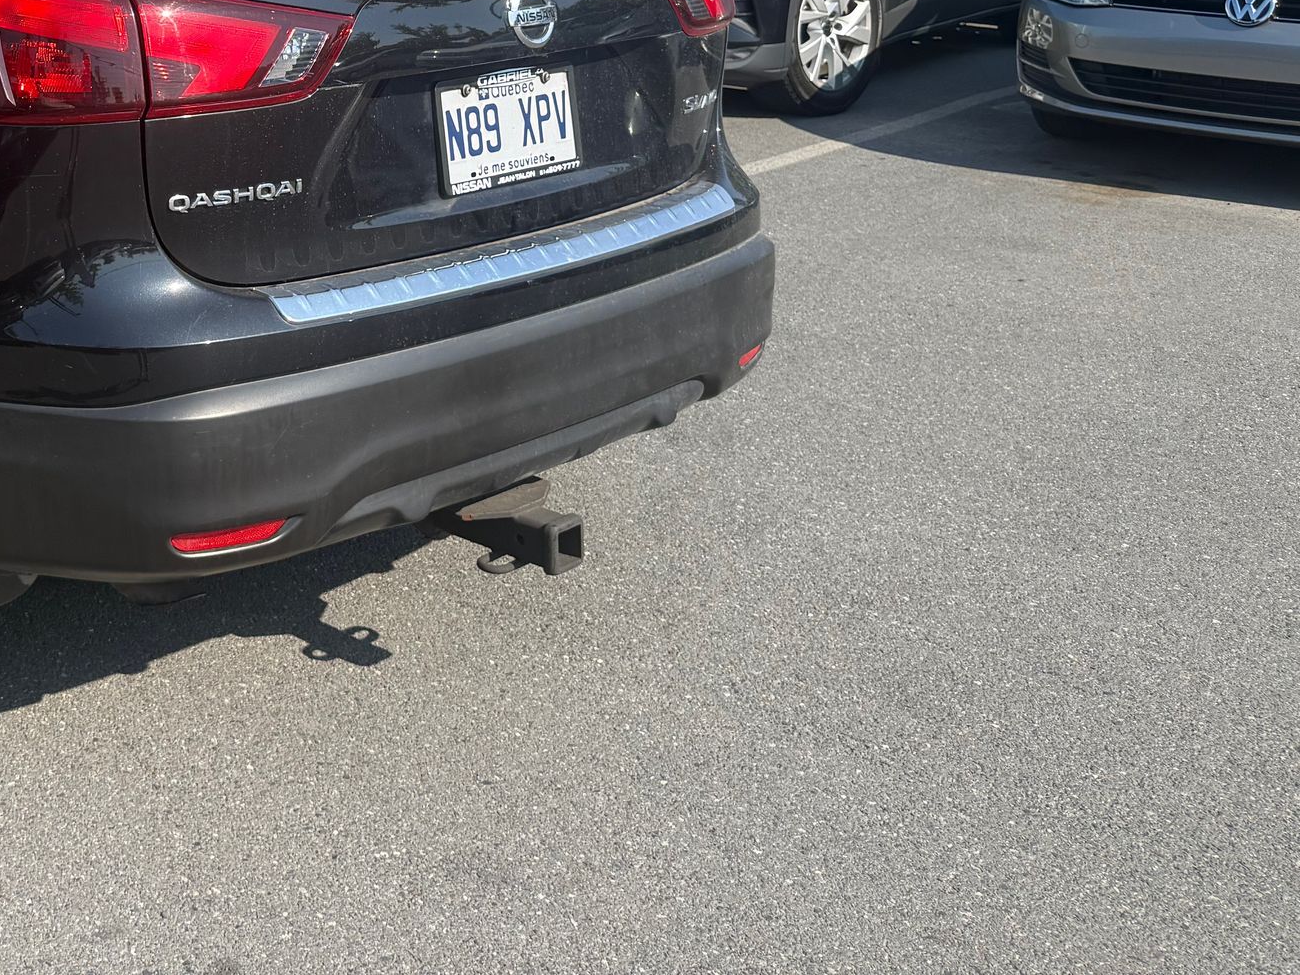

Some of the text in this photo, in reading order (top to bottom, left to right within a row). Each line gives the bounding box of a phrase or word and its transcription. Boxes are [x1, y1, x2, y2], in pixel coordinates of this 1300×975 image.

[516, 8, 556, 23] NISSAN
[445, 90, 567, 162] N89 XPV
[478, 152, 550, 176] Je me souviens
[168, 178, 303, 213] QASHQAI
[451, 178, 493, 196] NISSAN
